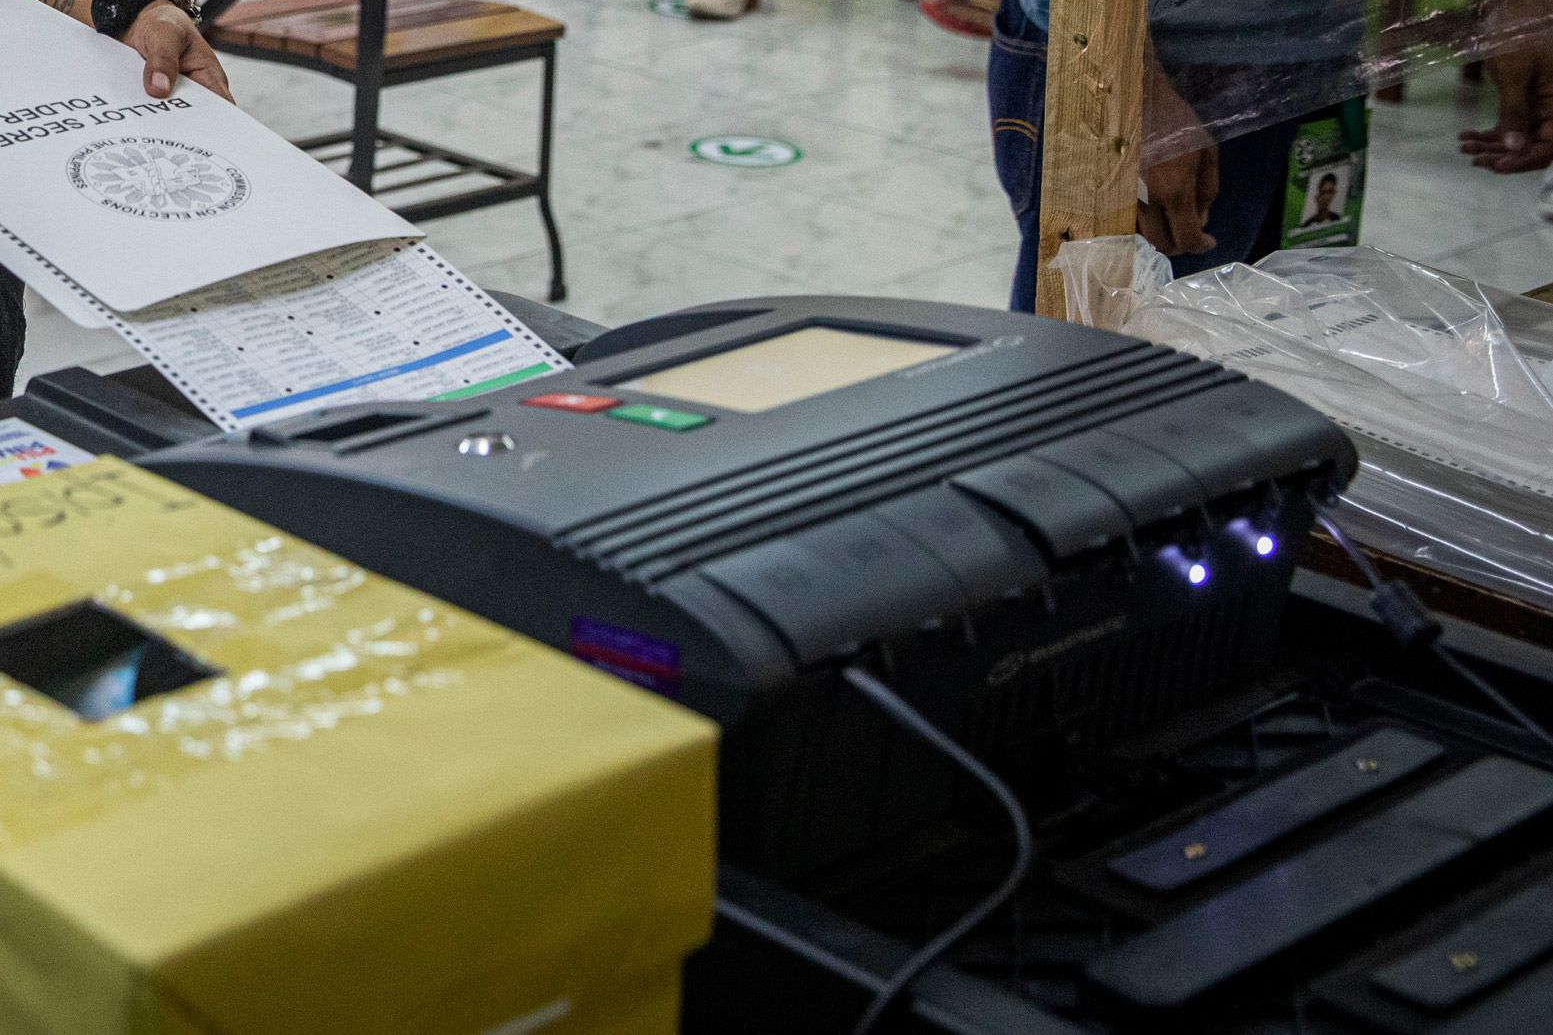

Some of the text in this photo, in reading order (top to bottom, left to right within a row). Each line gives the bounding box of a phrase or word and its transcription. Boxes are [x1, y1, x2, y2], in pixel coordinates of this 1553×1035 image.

[88, 97, 192, 125] BALLOT
[92, 138, 115, 149] THE
[142, 137, 213, 158] REPUBLIC
[70, 147, 94, 190] PHILIPPINES
[101, 167, 247, 220] COMMISSION ON ELECTIONS
